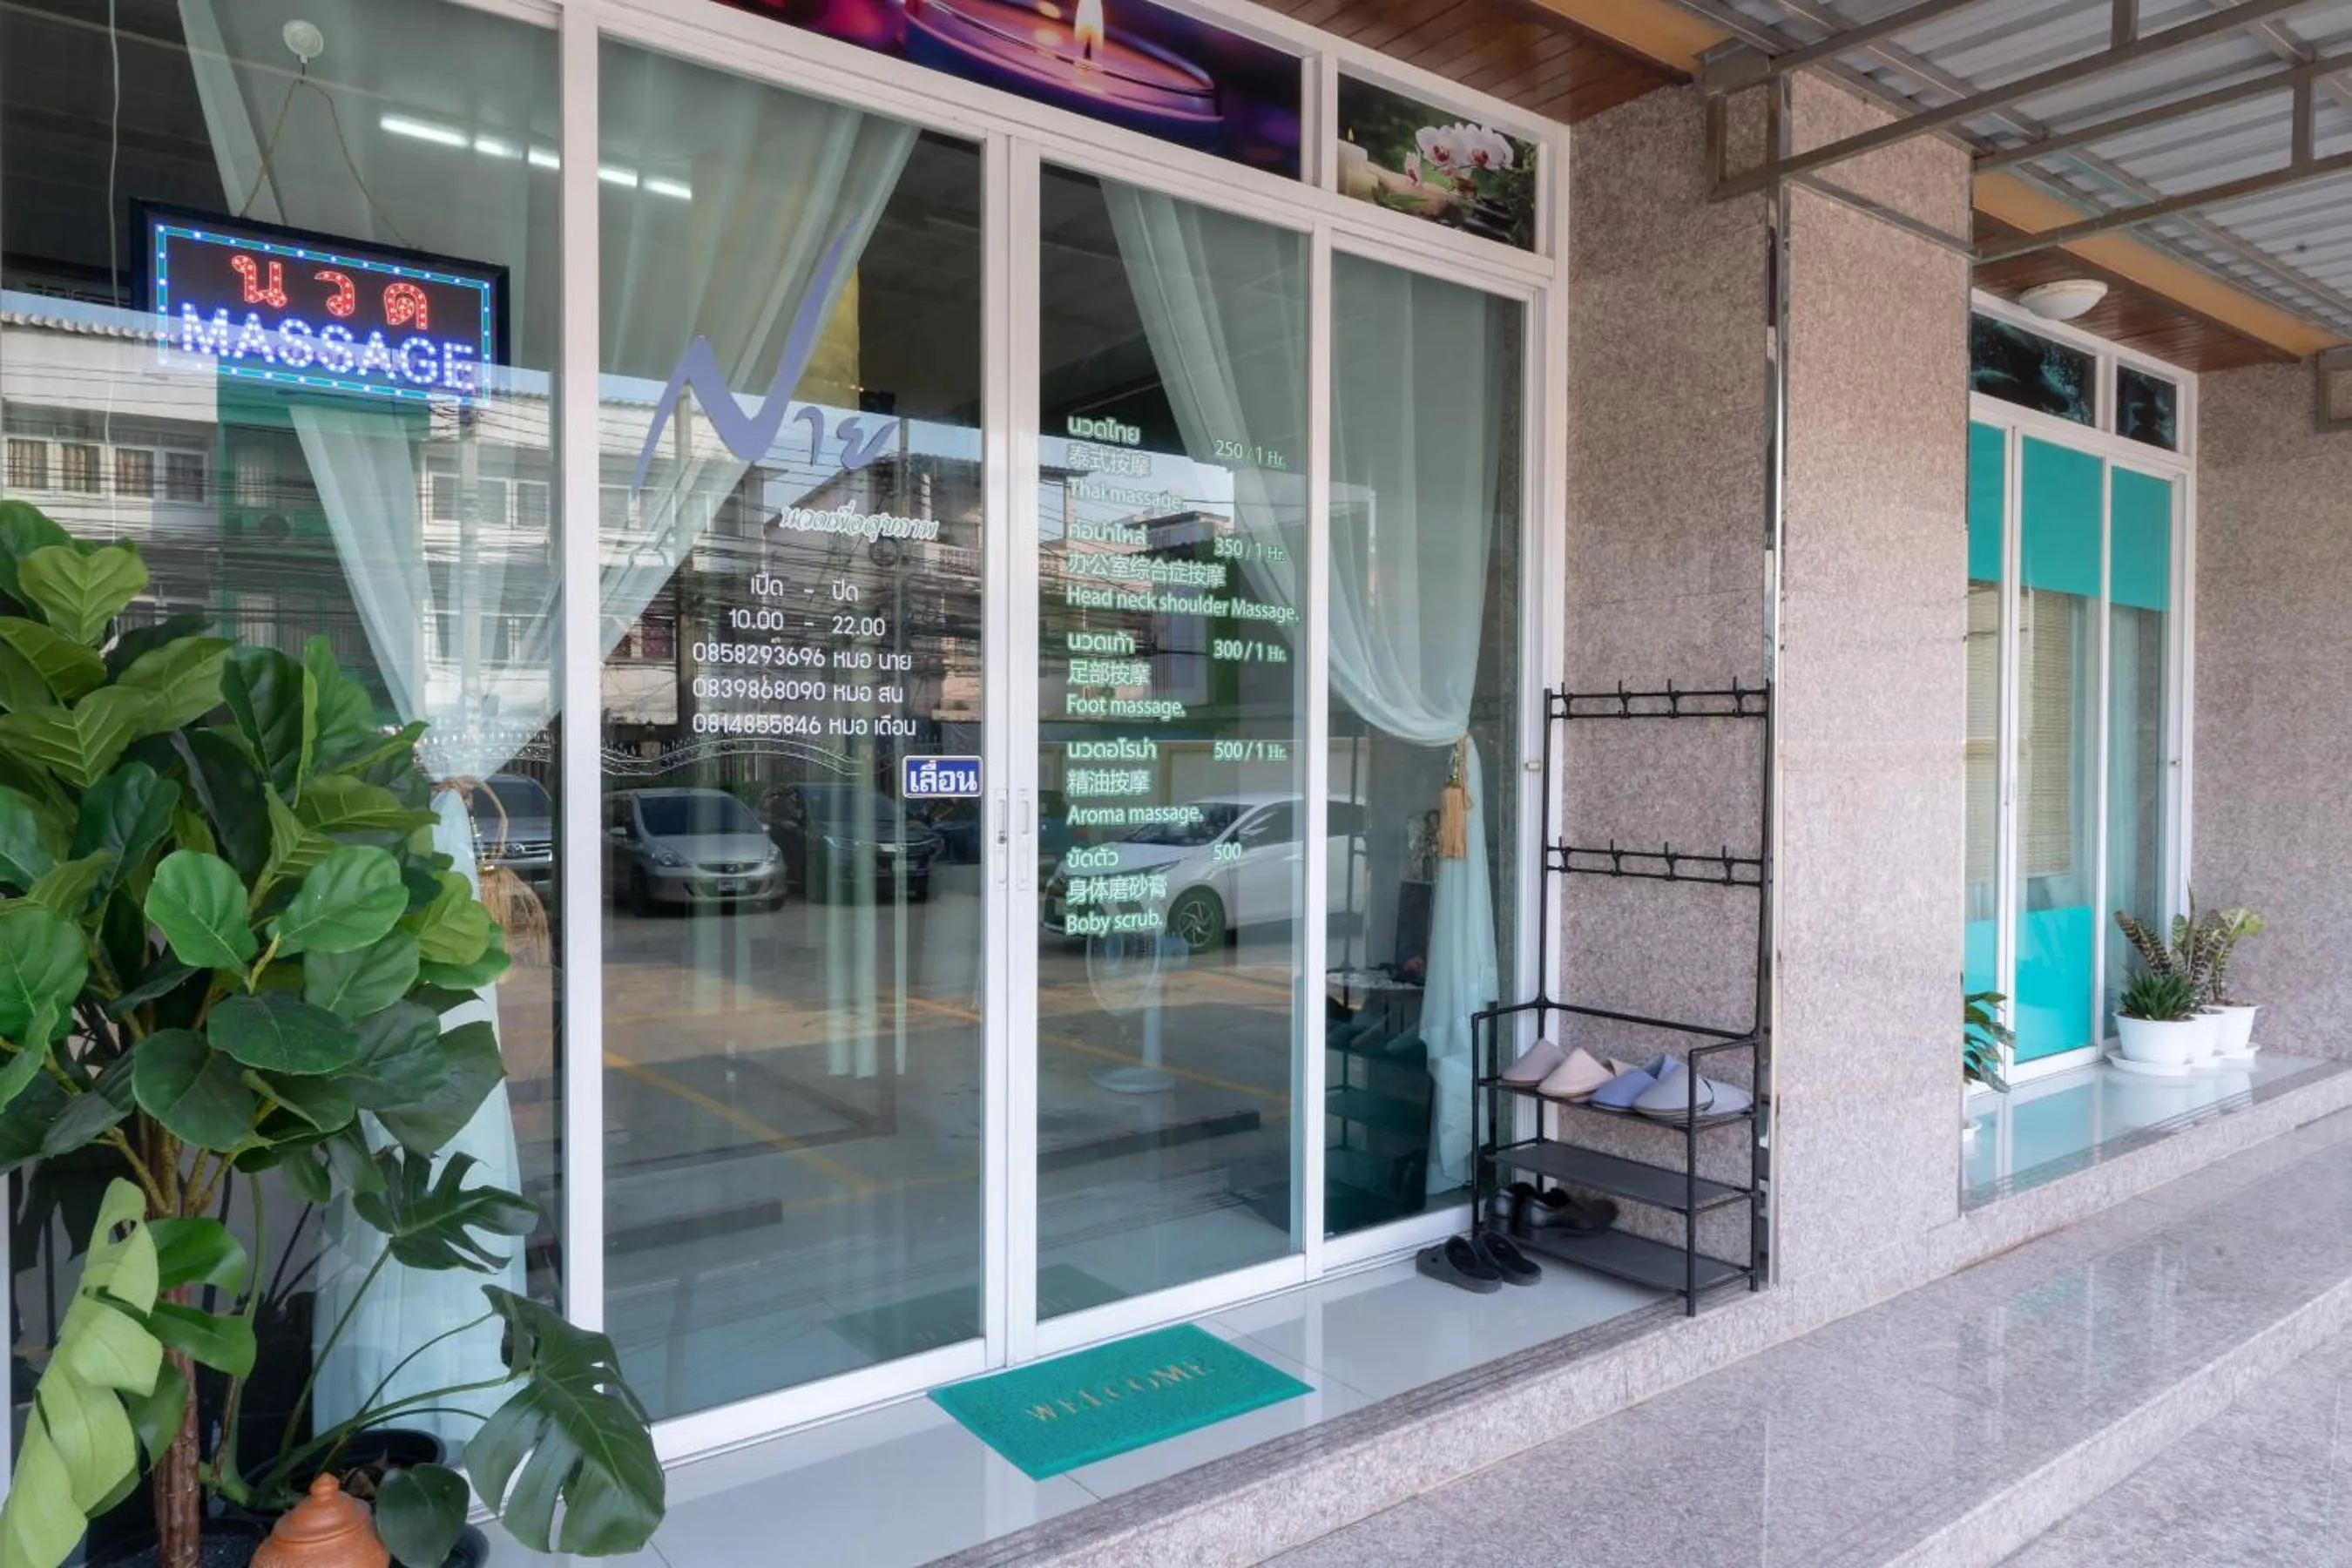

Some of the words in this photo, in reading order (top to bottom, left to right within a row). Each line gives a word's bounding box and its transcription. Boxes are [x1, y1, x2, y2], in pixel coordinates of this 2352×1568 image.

[231, 254, 429, 330] นวด
[181, 301, 476, 391] MASSAGE
[1067, 416, 1141, 445] นวดไทย
[1068, 444, 1152, 476] 泰式按摩
[1215, 439, 1243, 459] 250
[1068, 479, 1105, 500] Thai
[1213, 537, 1243, 558] 350
[750, 573, 783, 597] เปิด
[832, 578, 860, 603] ปิด
[1066, 585, 1112, 607] Head
[1117, 590, 1159, 611] neck
[1159, 593, 1230, 615] shoulder
[1231, 598, 1300, 624] Massage.
[729, 610, 784, 632] 10.00
[831, 615, 886, 637] 22.00
[1067, 632, 1135, 653] นวดเท้า
[1213, 639, 1243, 660] 300
[693, 642, 826, 668] 0858293696
[833, 649, 872, 670] หมอ
[878, 652, 913, 672] นาย
[1067, 659, 1152, 686] 足部按摩
[693, 679, 826, 701] 0839868090
[833, 683, 872, 703] หมอ
[1066, 694, 1106, 715] Foot
[1111, 699, 1186, 721] massage.
[693, 713, 821, 735] 0814855846
[828, 718, 868, 736] หมอ
[874, 713, 916, 737] เดือน
[1067, 737, 1157, 760] นวดอโรม่า
[1214, 741, 1243, 760] 500
[909, 760, 977, 793] เลื่อน
[1066, 770, 1151, 796] 精油按摩
[1066, 805, 1125, 826] Aroma
[1128, 806, 1204, 827] massage.
[1066, 847, 1119, 868] ขัดตัว
[1214, 842, 1242, 862] 500
[1066, 874, 1167, 905] 身体磨砂膏
[1066, 912, 1111, 937] Boby
[1113, 908, 1164, 929] scrub.
